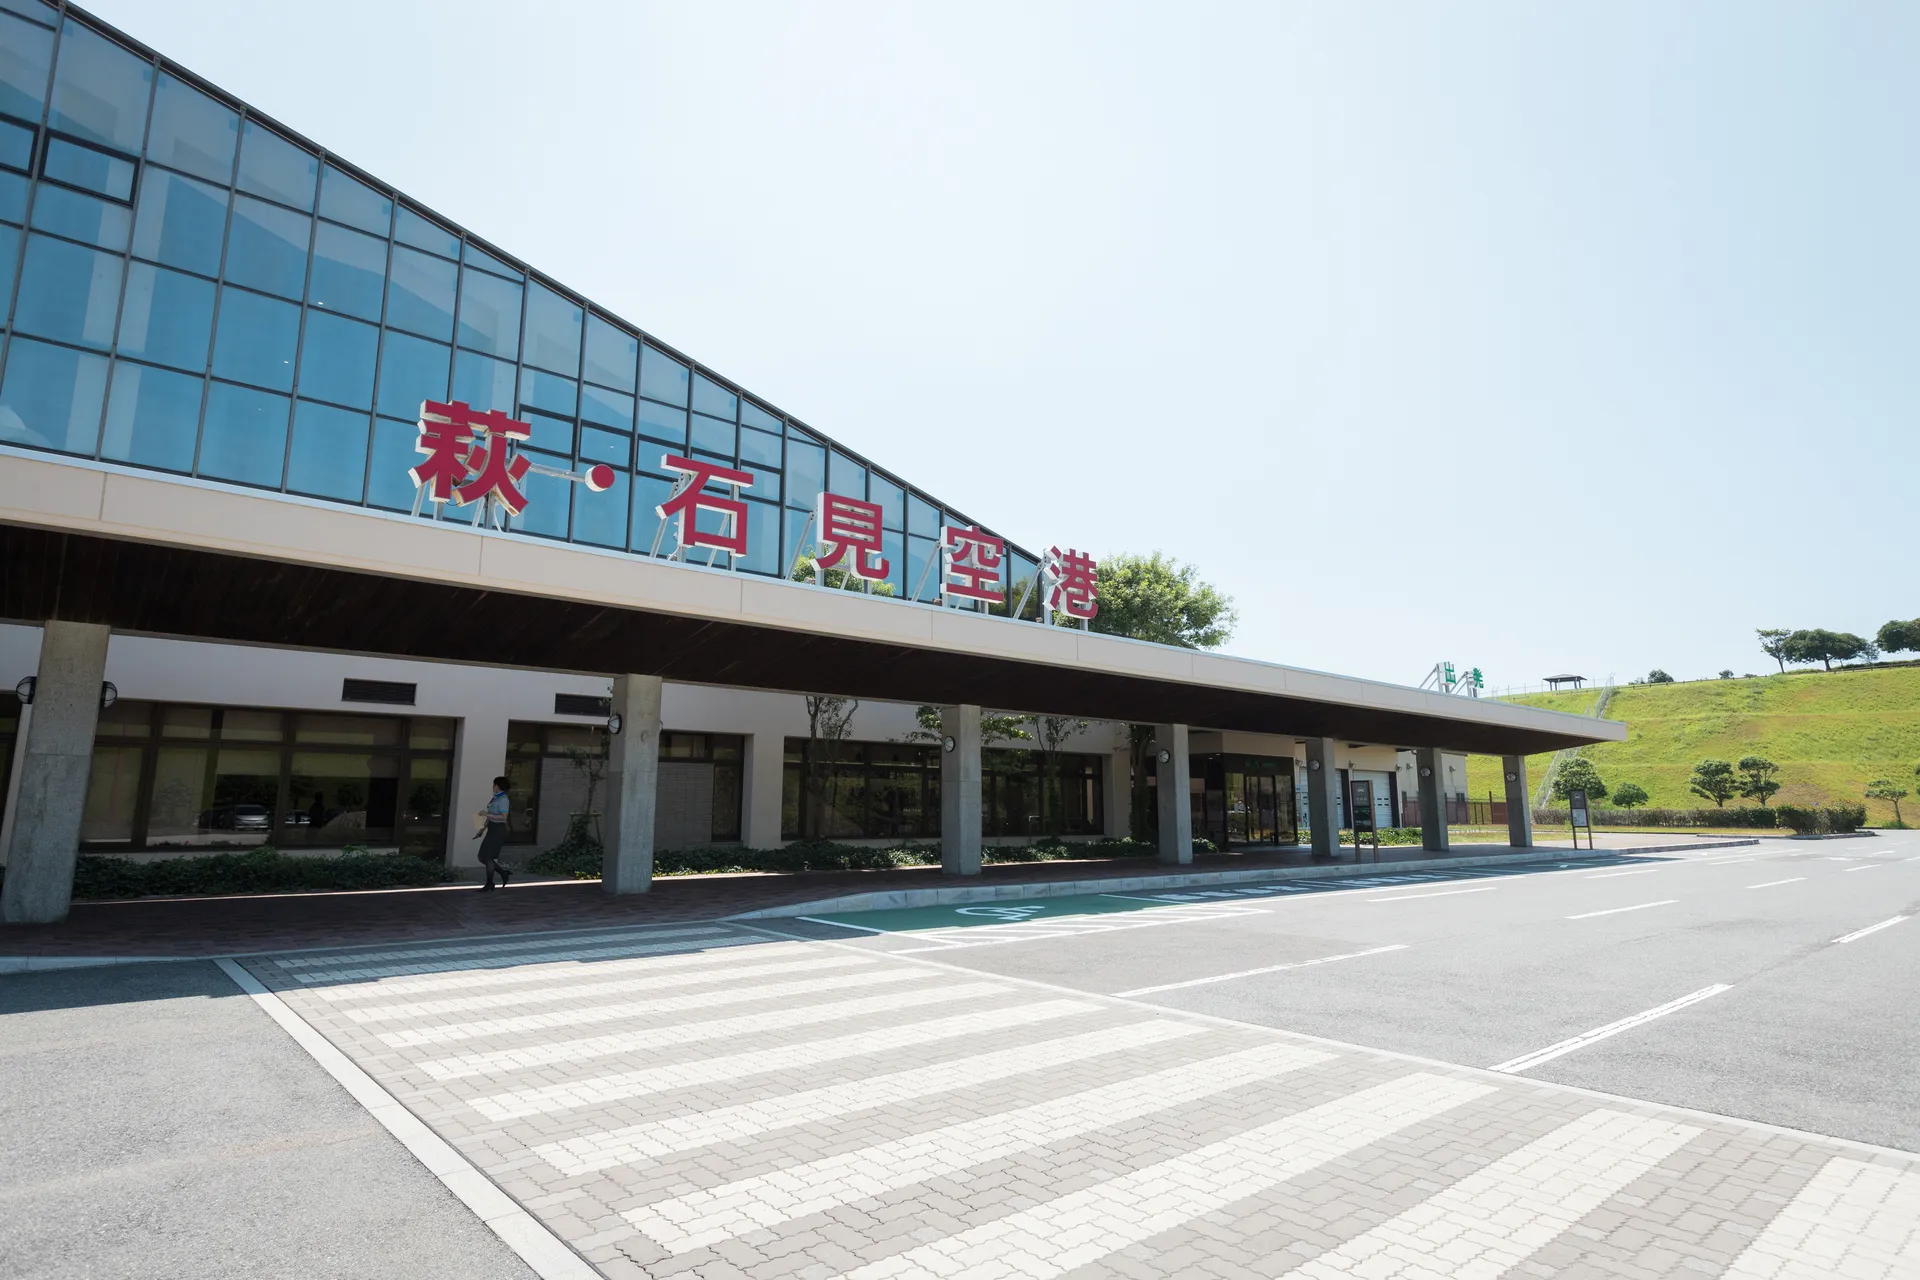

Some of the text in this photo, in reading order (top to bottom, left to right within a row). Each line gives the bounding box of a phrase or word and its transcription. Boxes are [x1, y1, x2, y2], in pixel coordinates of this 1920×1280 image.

[408, 400, 1099, 619] 萩・石見空港
